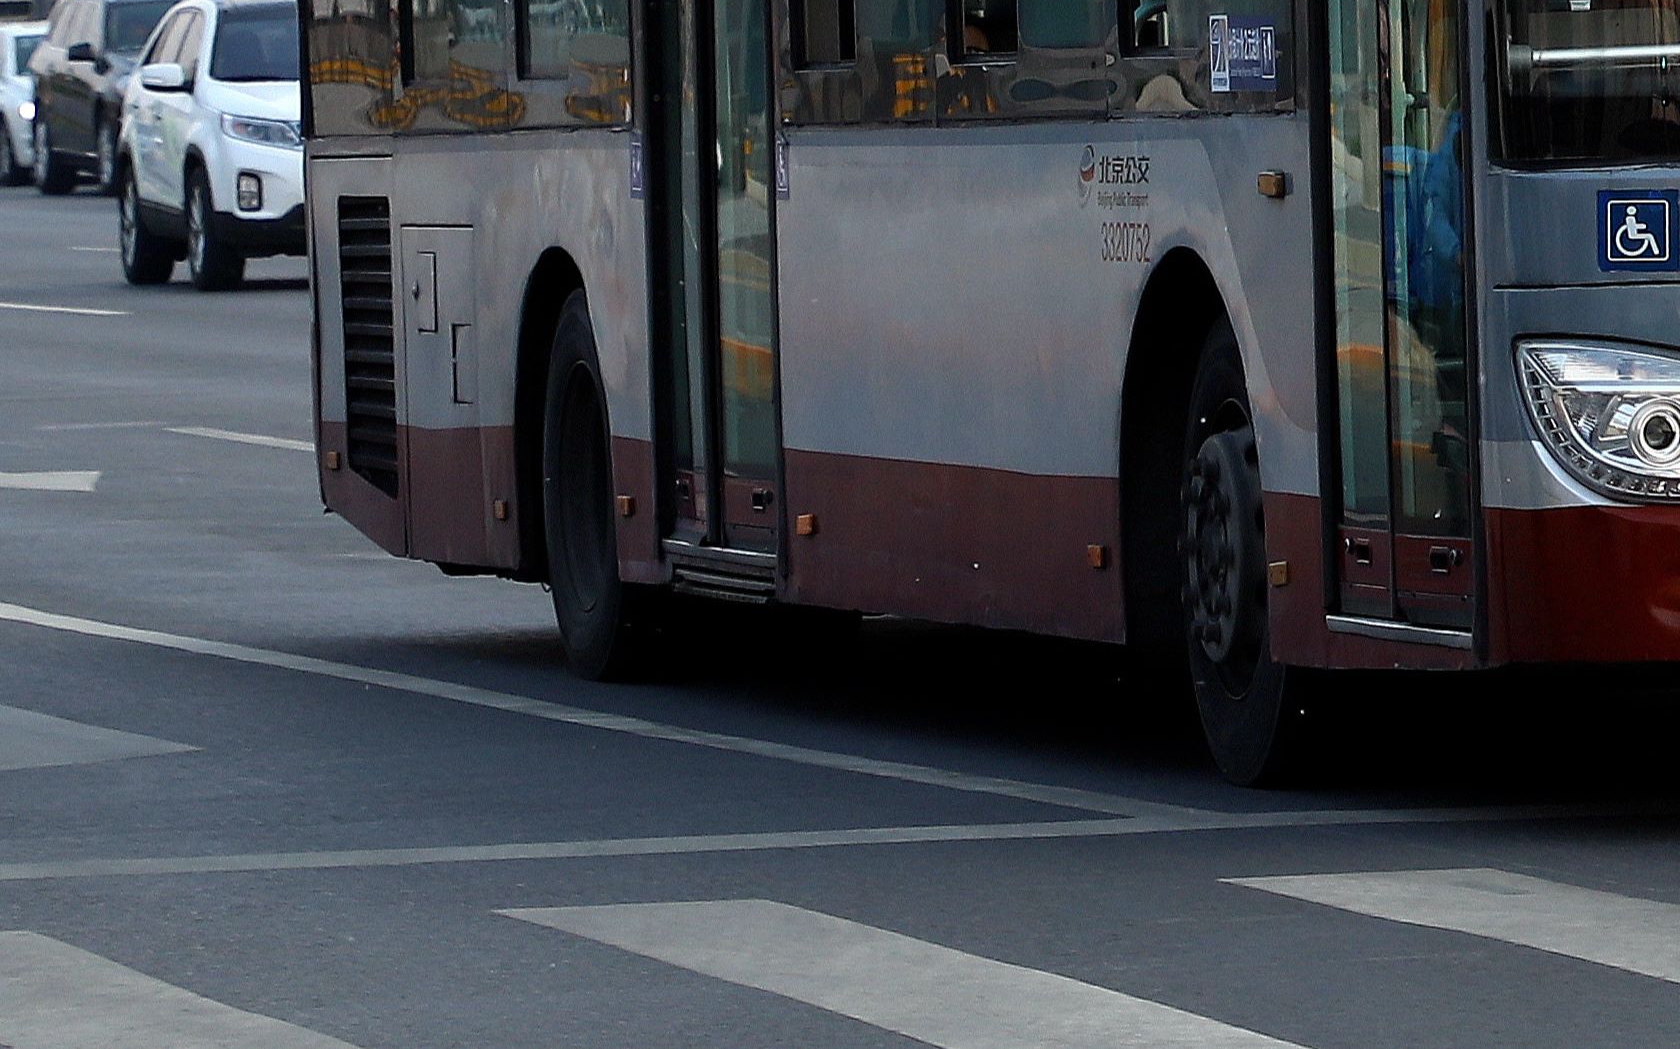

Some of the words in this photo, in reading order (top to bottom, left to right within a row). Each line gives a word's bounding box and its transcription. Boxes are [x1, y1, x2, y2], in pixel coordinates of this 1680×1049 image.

[1099, 155, 1150, 185] 北京公交
[1101, 222, 1151, 262] 3320752
